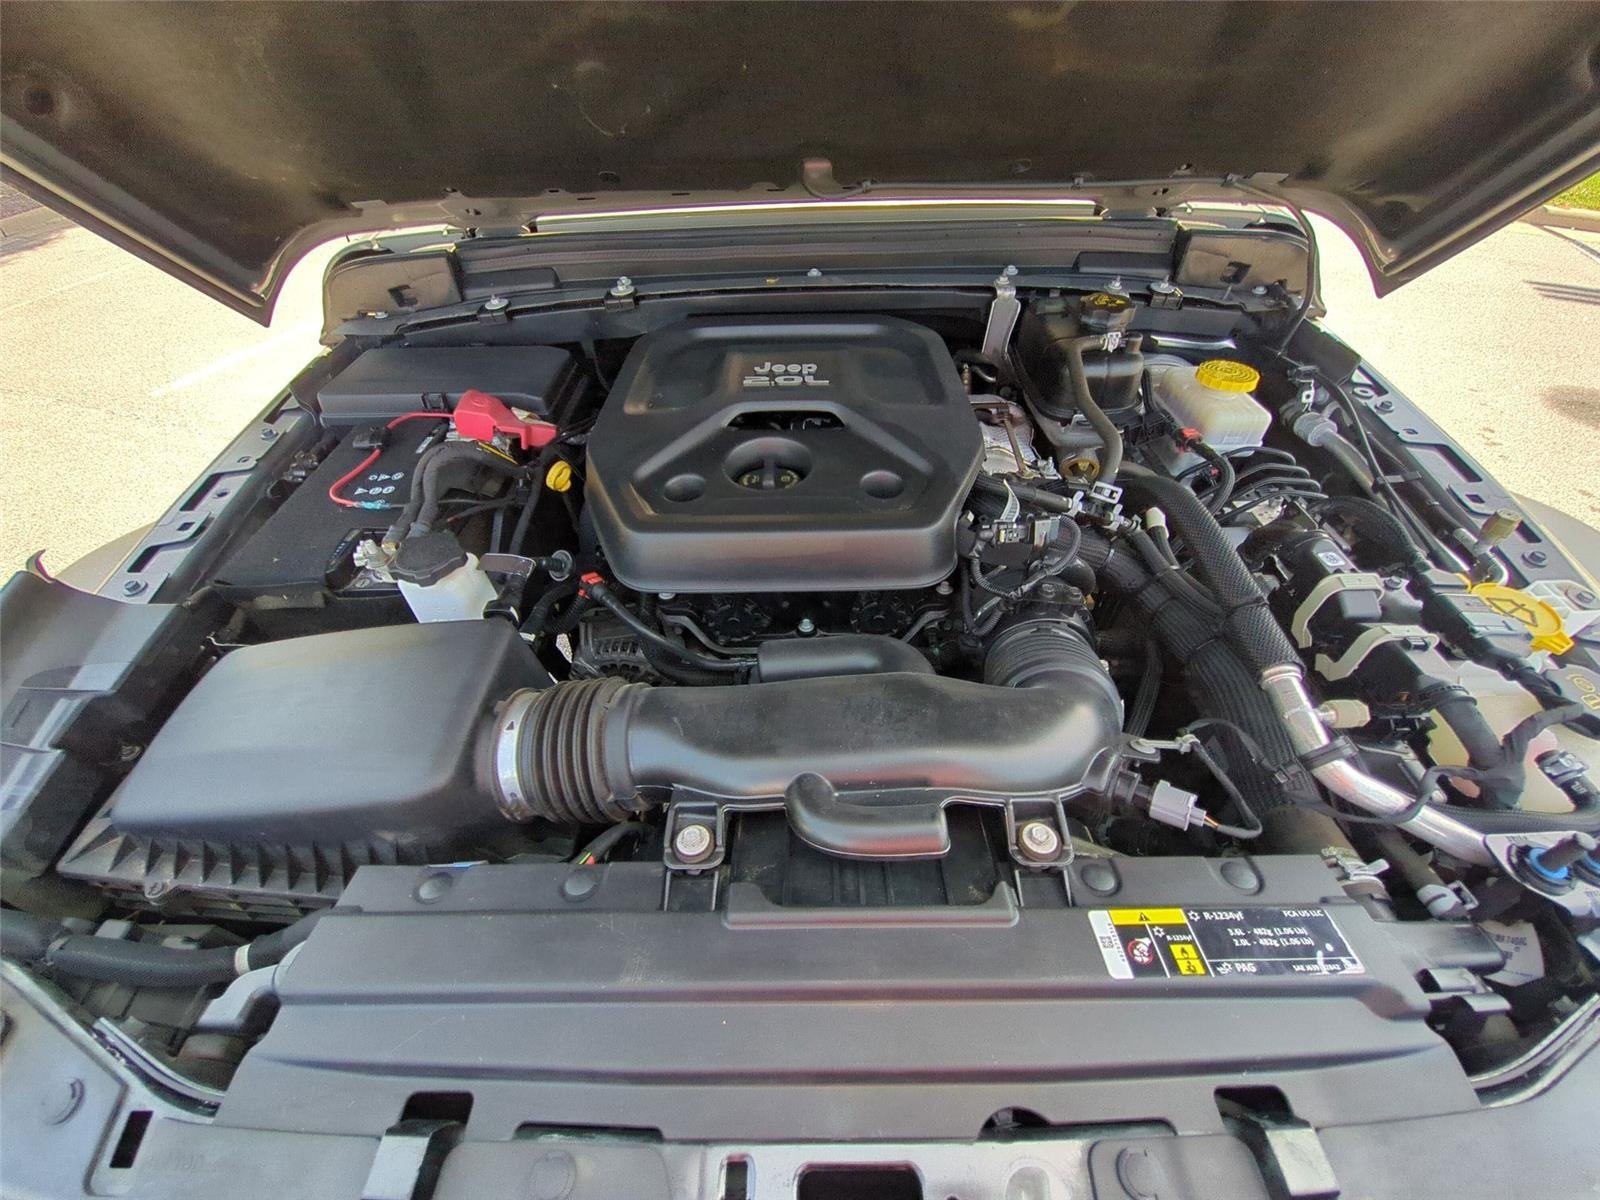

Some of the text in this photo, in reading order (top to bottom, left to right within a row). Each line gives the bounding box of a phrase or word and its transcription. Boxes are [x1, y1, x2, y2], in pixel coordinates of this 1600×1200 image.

[754, 362, 818, 375] Jeep
[743, 375, 830, 387] 2.0L
[1203, 911, 1244, 921] R-1234yf
[1233, 938, 1251, 946] 2.0L
[1235, 962, 1257, 973] PAG
